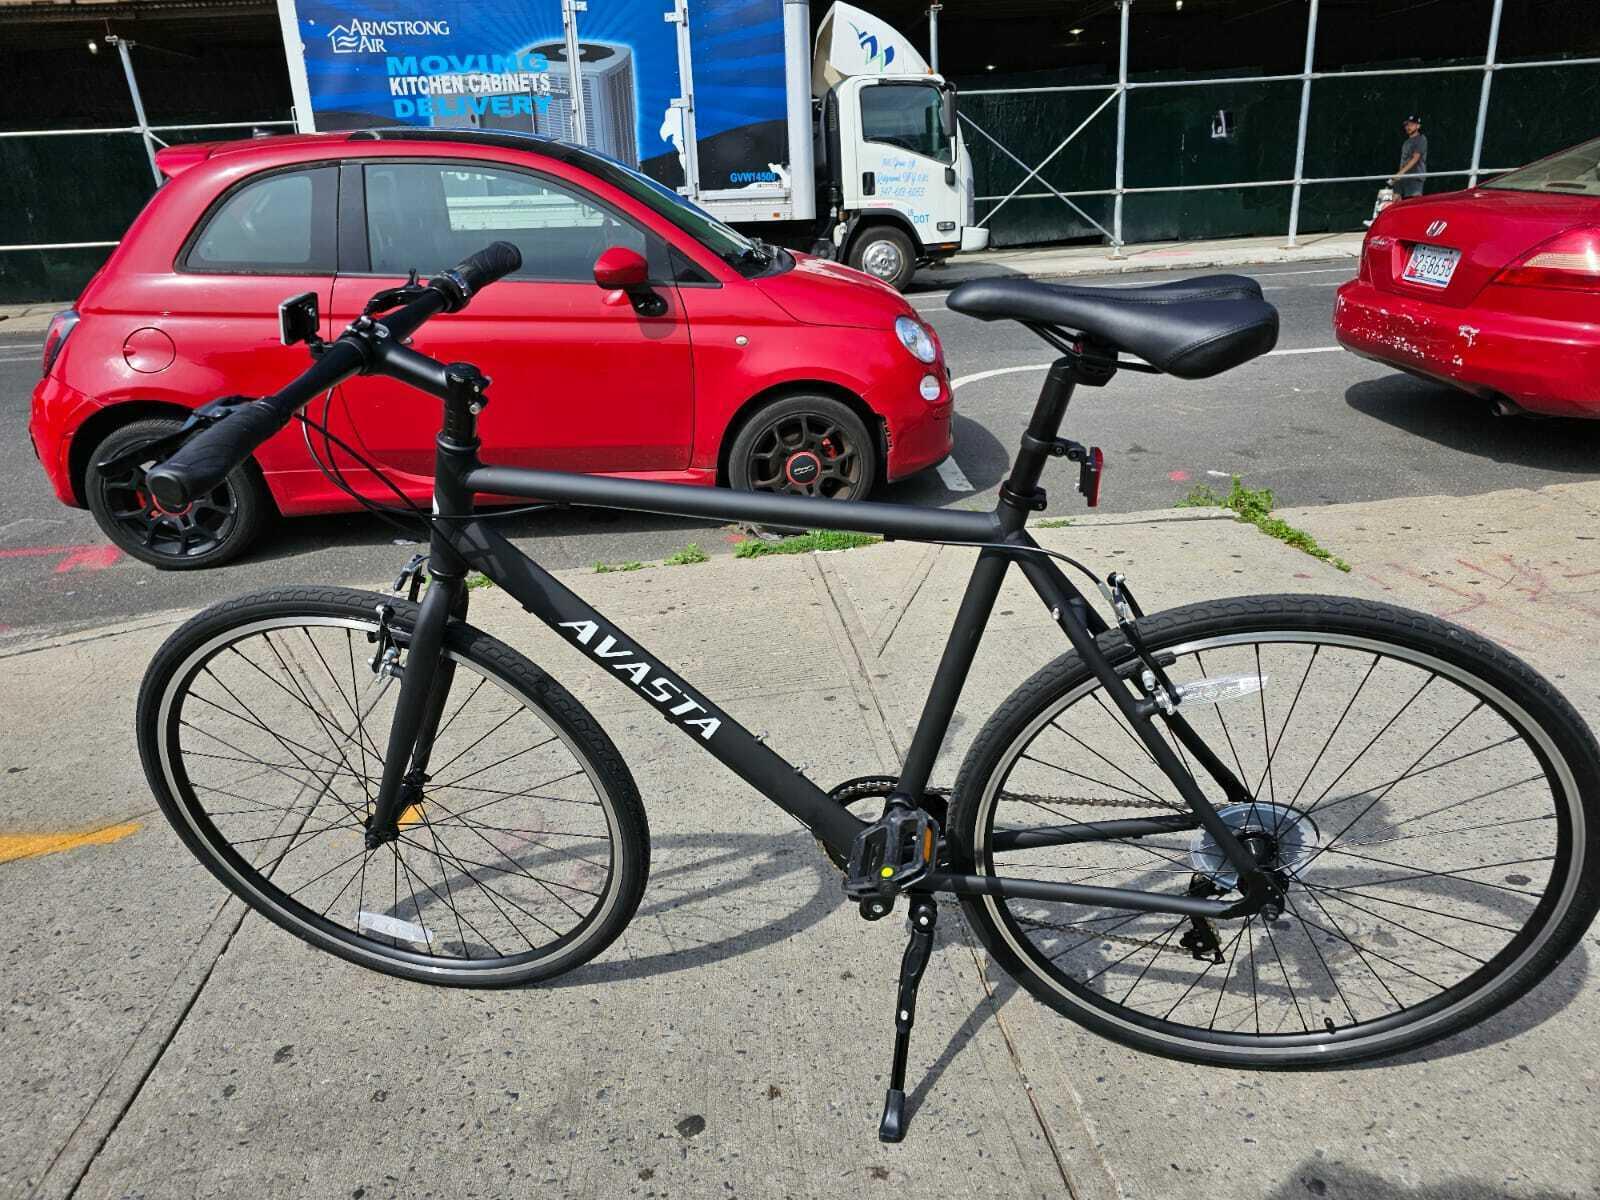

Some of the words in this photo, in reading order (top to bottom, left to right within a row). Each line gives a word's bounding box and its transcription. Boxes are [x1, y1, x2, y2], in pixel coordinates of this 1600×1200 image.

[349, 18, 450, 36] ARMSTRONG
[358, 36, 387, 53] AIR
[386, 54, 549, 75] MOVING
[389, 75, 465, 96] KITCHEN
[468, 72, 551, 93] CABINETS
[394, 96, 553, 118] DELIVERY
[729, 171, 776, 183] GVW14500
[913, 213, 930, 224] DOT
[558, 620, 722, 740] AVASTA
